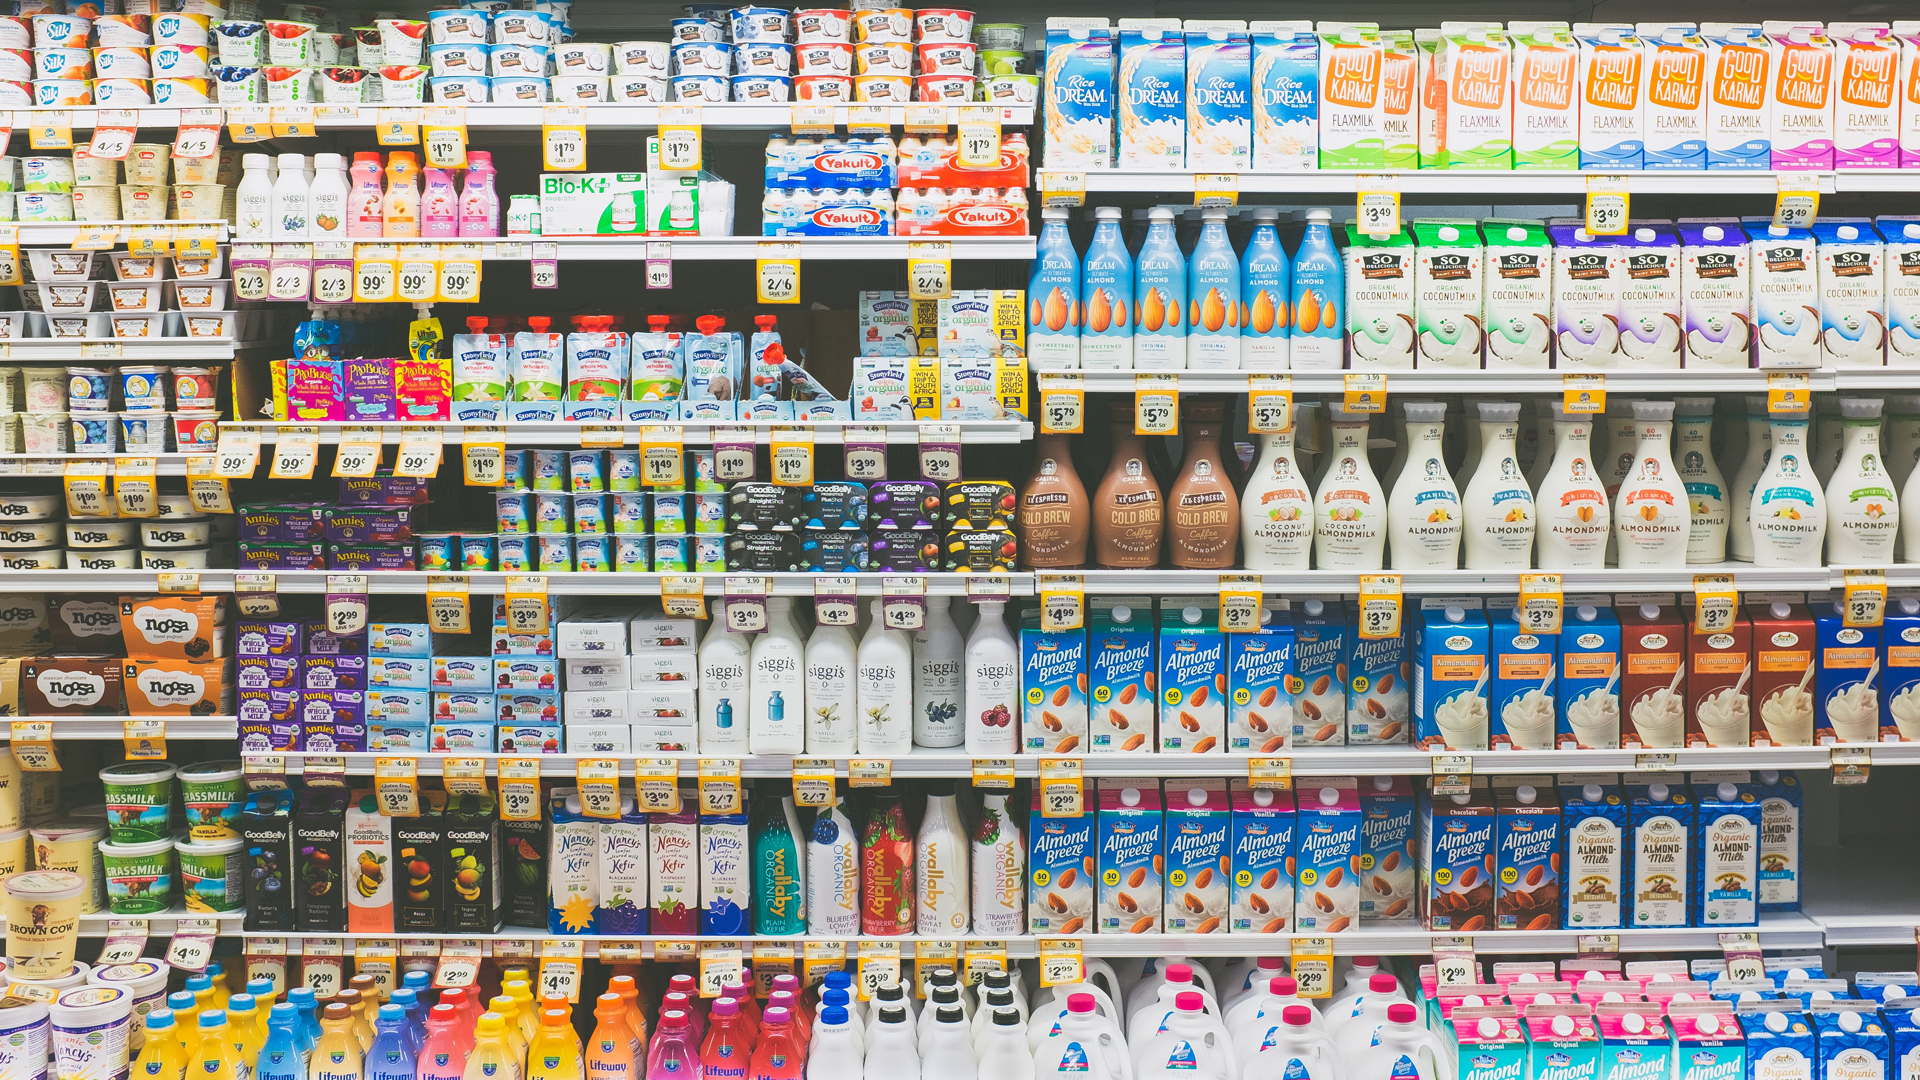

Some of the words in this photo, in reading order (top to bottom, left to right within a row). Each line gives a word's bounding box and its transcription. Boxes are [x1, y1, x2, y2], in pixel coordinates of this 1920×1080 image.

[448, 18, 460, 26] SO
[508, 18, 520, 26] SO
[48, 21, 70, 39] Silk
[229, 40, 245, 48] daiya
[1334, 49, 1374, 80] GOOD
[1530, 51, 1566, 83] GOOD
[1659, 50, 1698, 84] GOOD
[1786, 50, 1824, 83] GOOD
[1068, 75, 1094, 87] Rice
[1208, 77, 1235, 89] Rice
[1331, 80, 1372, 104] KARMA
[1526, 80, 1566, 105] KARMA
[1782, 80, 1822, 104] KARMA
[1332, 114, 1374, 126] FLAXMILK
[1528, 116, 1568, 128] FLAXMILK
[1784, 115, 1823, 127] FLAXMILK
[825, 158, 871, 169] Yakult
[824, 213, 870, 223] Yakult
[1708, 255, 1726, 264] SO
[1356, 291, 1409, 300] COCONUTMILK
[1690, 291, 1743, 300] COCONUTMILK
[1827, 290, 1878, 298] COCONUTMILK
[461, 352, 494, 360] Stonyfield
[692, 366, 726, 374] organic
[868, 383, 905, 394] organic
[460, 411, 494, 420] Stonyfield
[575, 410, 610, 419] Stonyfield
[747, 486, 785, 495] GoodBelly
[245, 514, 279, 528] Annie's
[1112, 511, 1134, 524] COLD
[1138, 510, 1160, 522] BREW
[1178, 512, 1197, 524] COLD
[1200, 510, 1228, 523] BREW
[74, 531, 107, 542] noosa
[1126, 529, 1152, 539] Coffee
[1190, 529, 1218, 540] Coffee
[146, 620, 188, 633] noosa
[239, 625, 267, 634] Annie's
[1095, 641, 1149, 669] Almond
[1234, 644, 1289, 672] Almond
[1569, 657, 1612, 665] Almondmilk
[1763, 655, 1806, 663] Almondmilk
[306, 658, 335, 668] Annie's
[758, 657, 795, 672] siggi's
[808, 664, 845, 679] siggi's
[1106, 659, 1144, 680] Breeze
[1246, 661, 1284, 683] Breeze
[50, 681, 95, 695] noosa
[245, 830, 286, 840] GoodBelly
[399, 831, 440, 840] GoodBelly
[1034, 827, 1089, 853] Almond
[1302, 826, 1357, 852] Almond
[1713, 833, 1750, 843] Organic
[559, 835, 594, 854] Nancy's
[654, 836, 690, 854] Nancy's
[1713, 843, 1752, 851] ALMOND-
[1046, 843, 1083, 864] Breeze
[1582, 855, 1609, 864] Milk
[1718, 852, 1744, 862] Milk
[107, 865, 163, 876] GRASSMILK
[564, 860, 589, 874] Kefir
[660, 861, 685, 875] Kefir
[765, 850, 775, 907] ORGANIC
[774, 848, 792, 918] wallaby
[925, 842, 943, 912] wallaby
[827, 913, 858, 923] BLUEBERRY
[10, 923, 48, 935] BROWN
[50, 923, 74, 934] COW
[829, 921, 856, 929] LOWFAT
[590, 1060, 626, 1072] Lifeway
[705, 1066, 744, 1077] Lifeway
[1763, 1068, 1803, 1078] Organic
